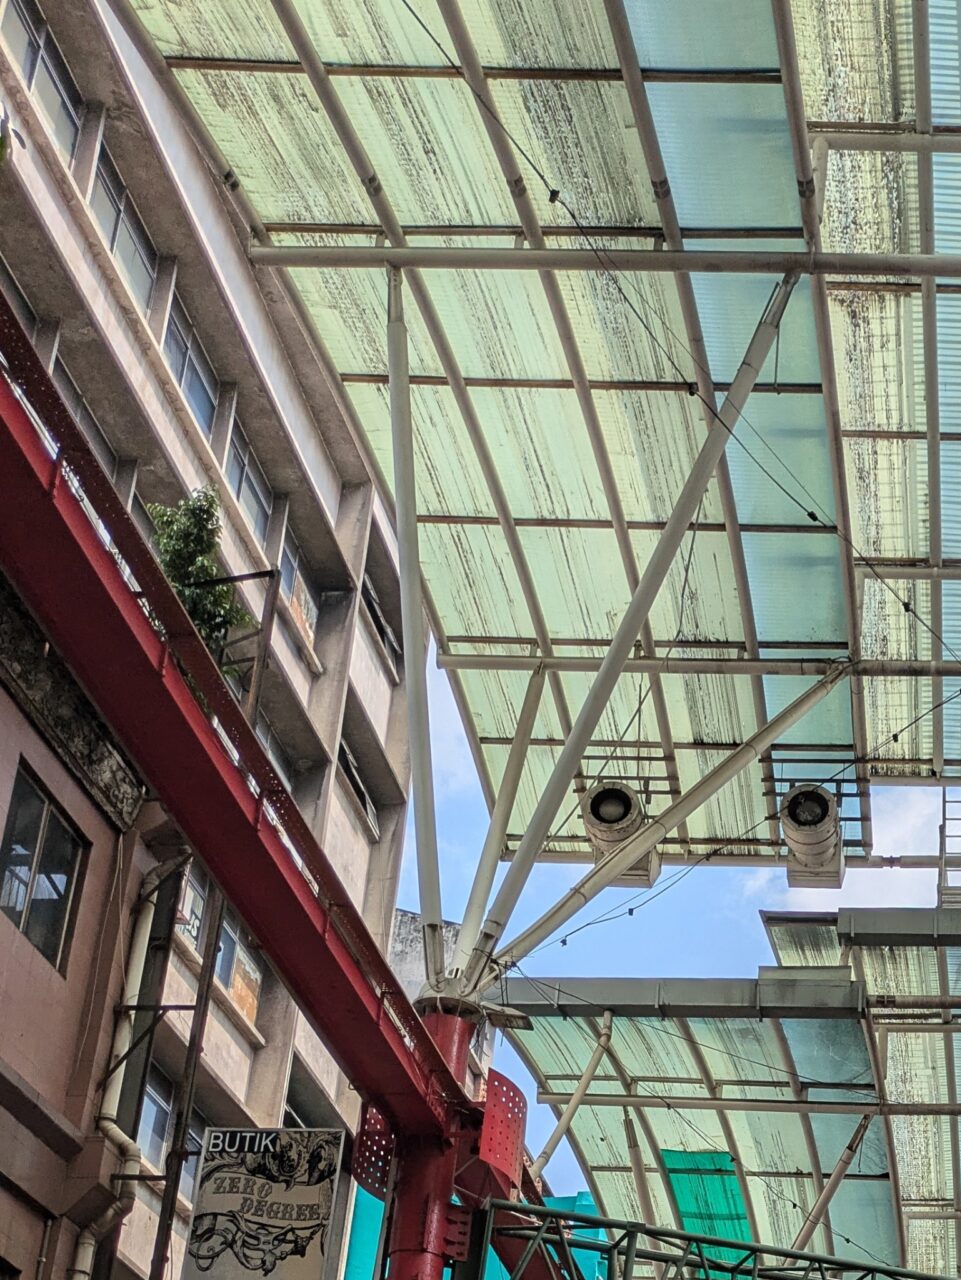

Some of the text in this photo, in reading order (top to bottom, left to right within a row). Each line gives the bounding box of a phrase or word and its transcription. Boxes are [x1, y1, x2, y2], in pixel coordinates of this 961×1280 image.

[208, 1132, 277, 1152] BUTIK
[213, 1177, 272, 1199] ZERO
[241, 1197, 320, 1221] DEGREE
